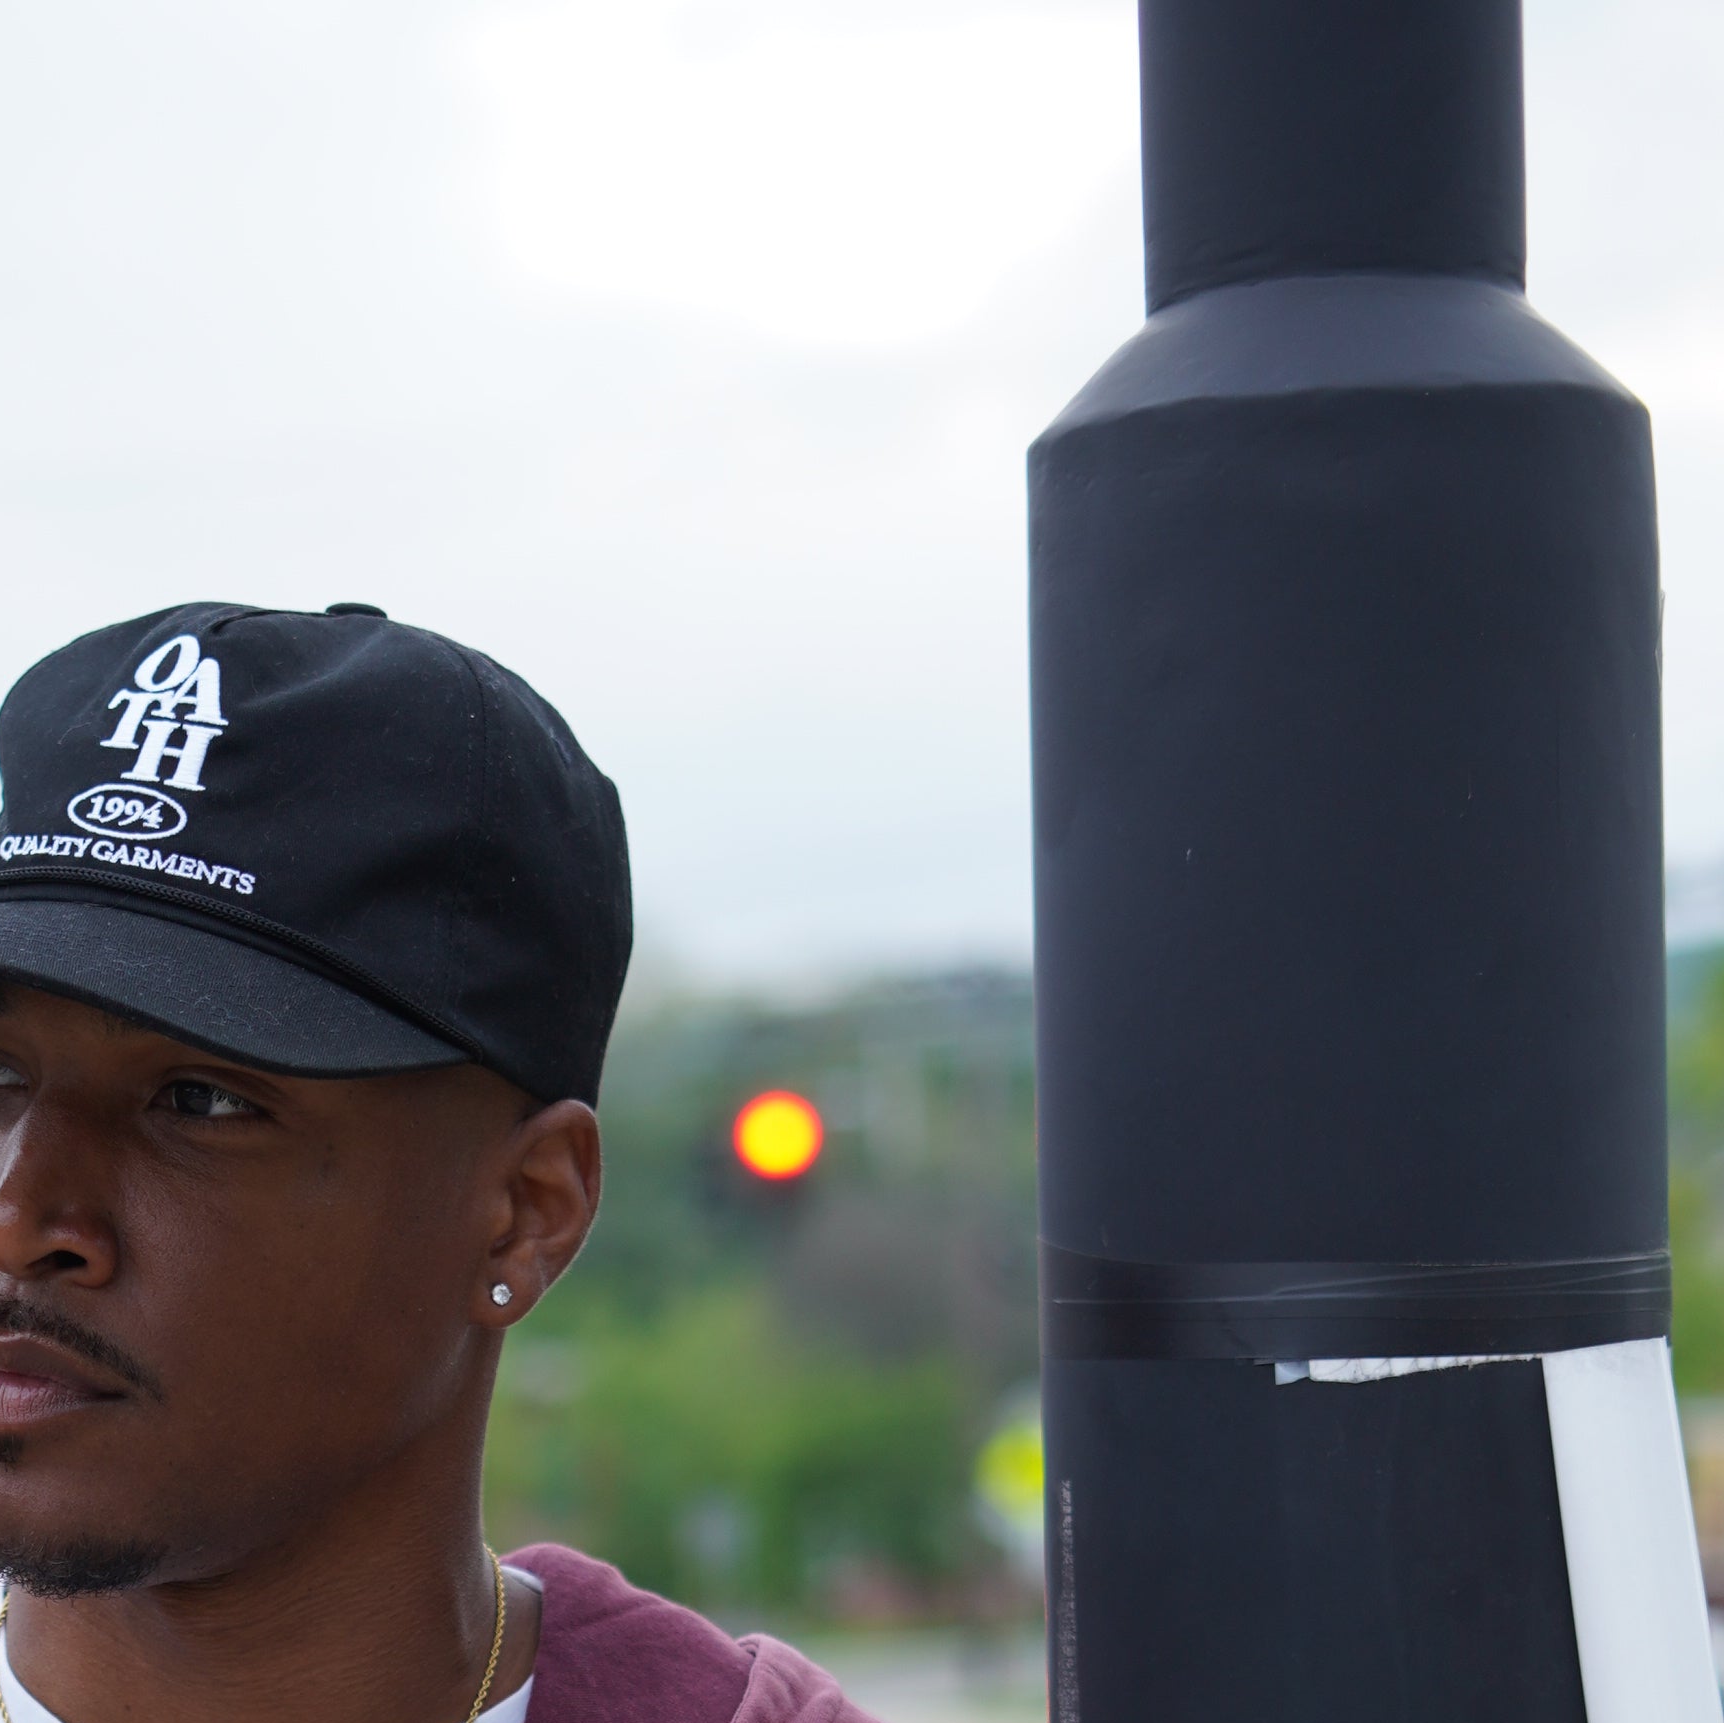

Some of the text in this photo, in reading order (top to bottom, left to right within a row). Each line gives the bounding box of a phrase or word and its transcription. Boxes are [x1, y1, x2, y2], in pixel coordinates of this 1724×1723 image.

[86, 795, 164, 829] 1994
[0, 835, 256, 895] QUALITY GARMENTS
